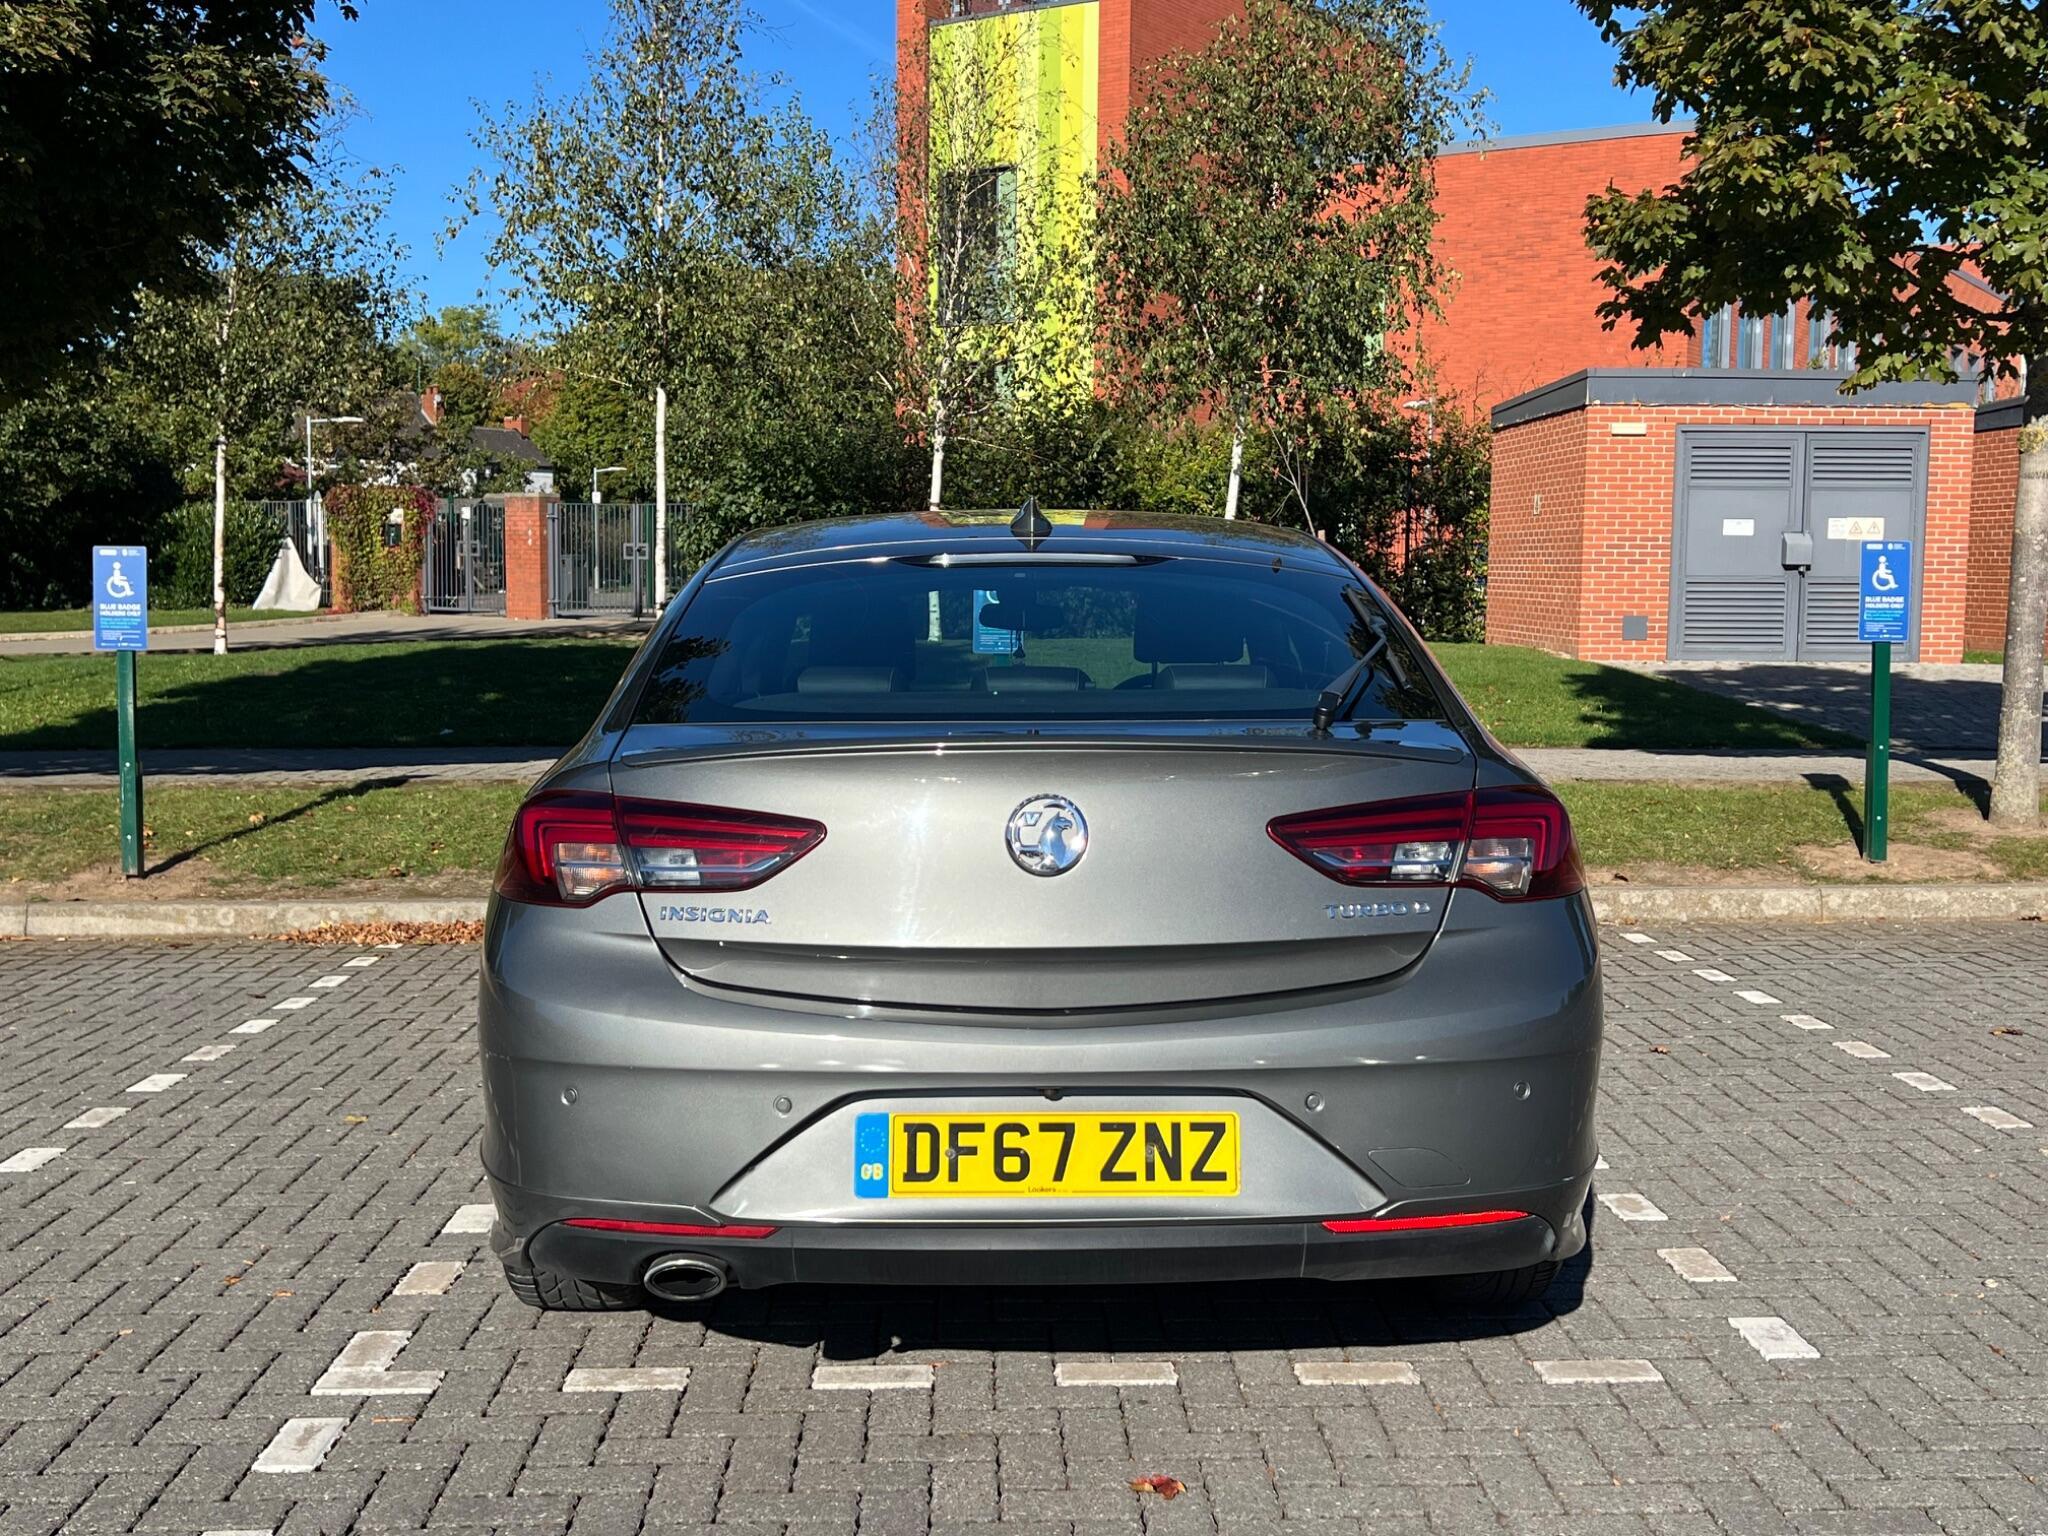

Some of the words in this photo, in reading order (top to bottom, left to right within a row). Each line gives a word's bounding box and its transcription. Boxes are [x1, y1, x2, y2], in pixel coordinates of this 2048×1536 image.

[660, 906, 771, 924] INSIGNIA
[1323, 902, 1408, 919] TURBO
[1414, 901, 1430, 914] D
[903, 1122, 1076, 1183] DF67
[1100, 1122, 1227, 1182] ZNZ
[861, 1163, 883, 1181] GB
[1027, 1185, 1057, 1193] Lookers
